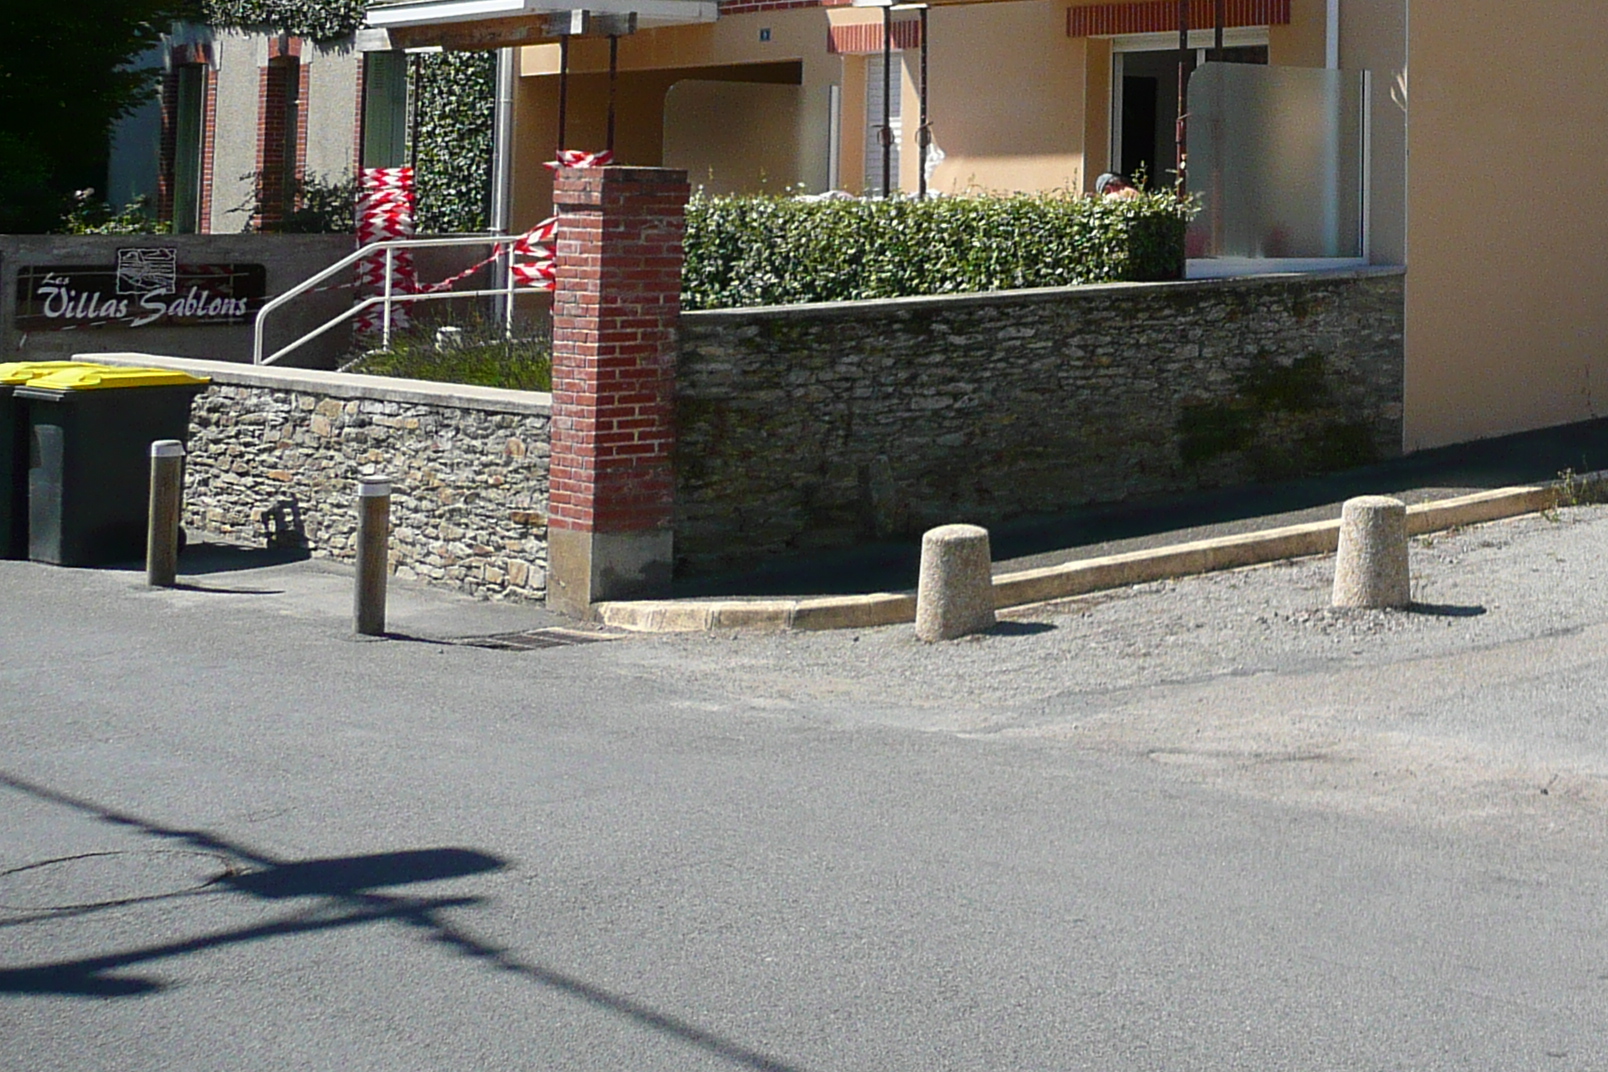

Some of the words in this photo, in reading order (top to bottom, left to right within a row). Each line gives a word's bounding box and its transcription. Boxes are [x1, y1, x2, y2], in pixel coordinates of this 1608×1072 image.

[41, 272, 70, 285] Les
[37, 286, 129, 318] Villas
[130, 286, 248, 327] Sablons
